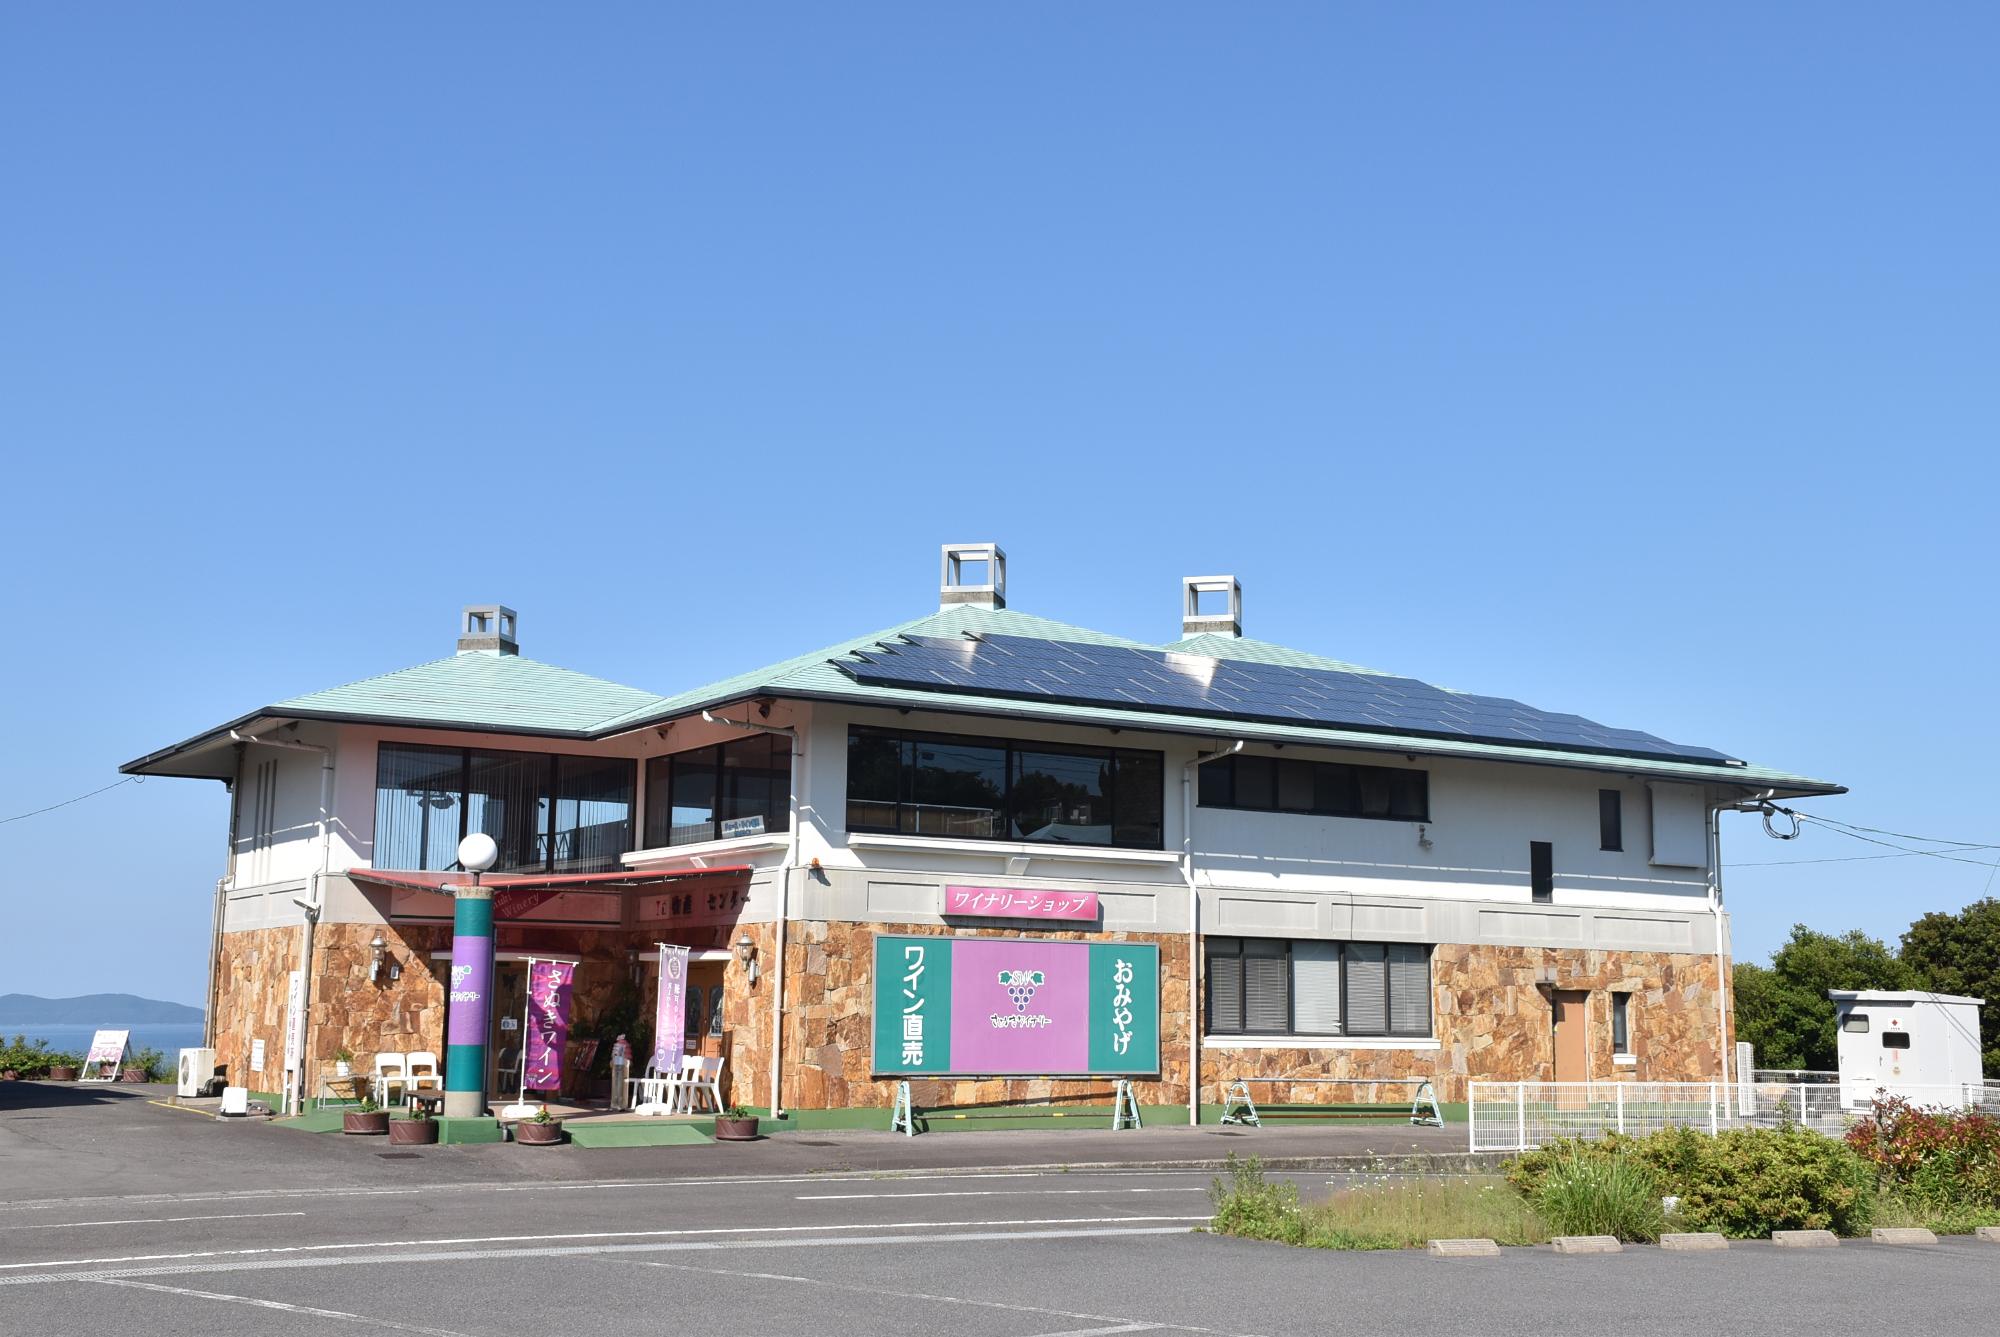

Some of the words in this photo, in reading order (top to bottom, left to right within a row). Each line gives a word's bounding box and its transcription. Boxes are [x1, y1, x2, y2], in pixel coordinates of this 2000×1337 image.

[502, 892, 539, 917] Winery
[954, 891, 1089, 914] ワイナリーショップ
[538, 969, 562, 1084] さぬきワイン
[902, 945, 925, 1066] ワイン直売
[1113, 958, 1134, 1056] おみやげ
